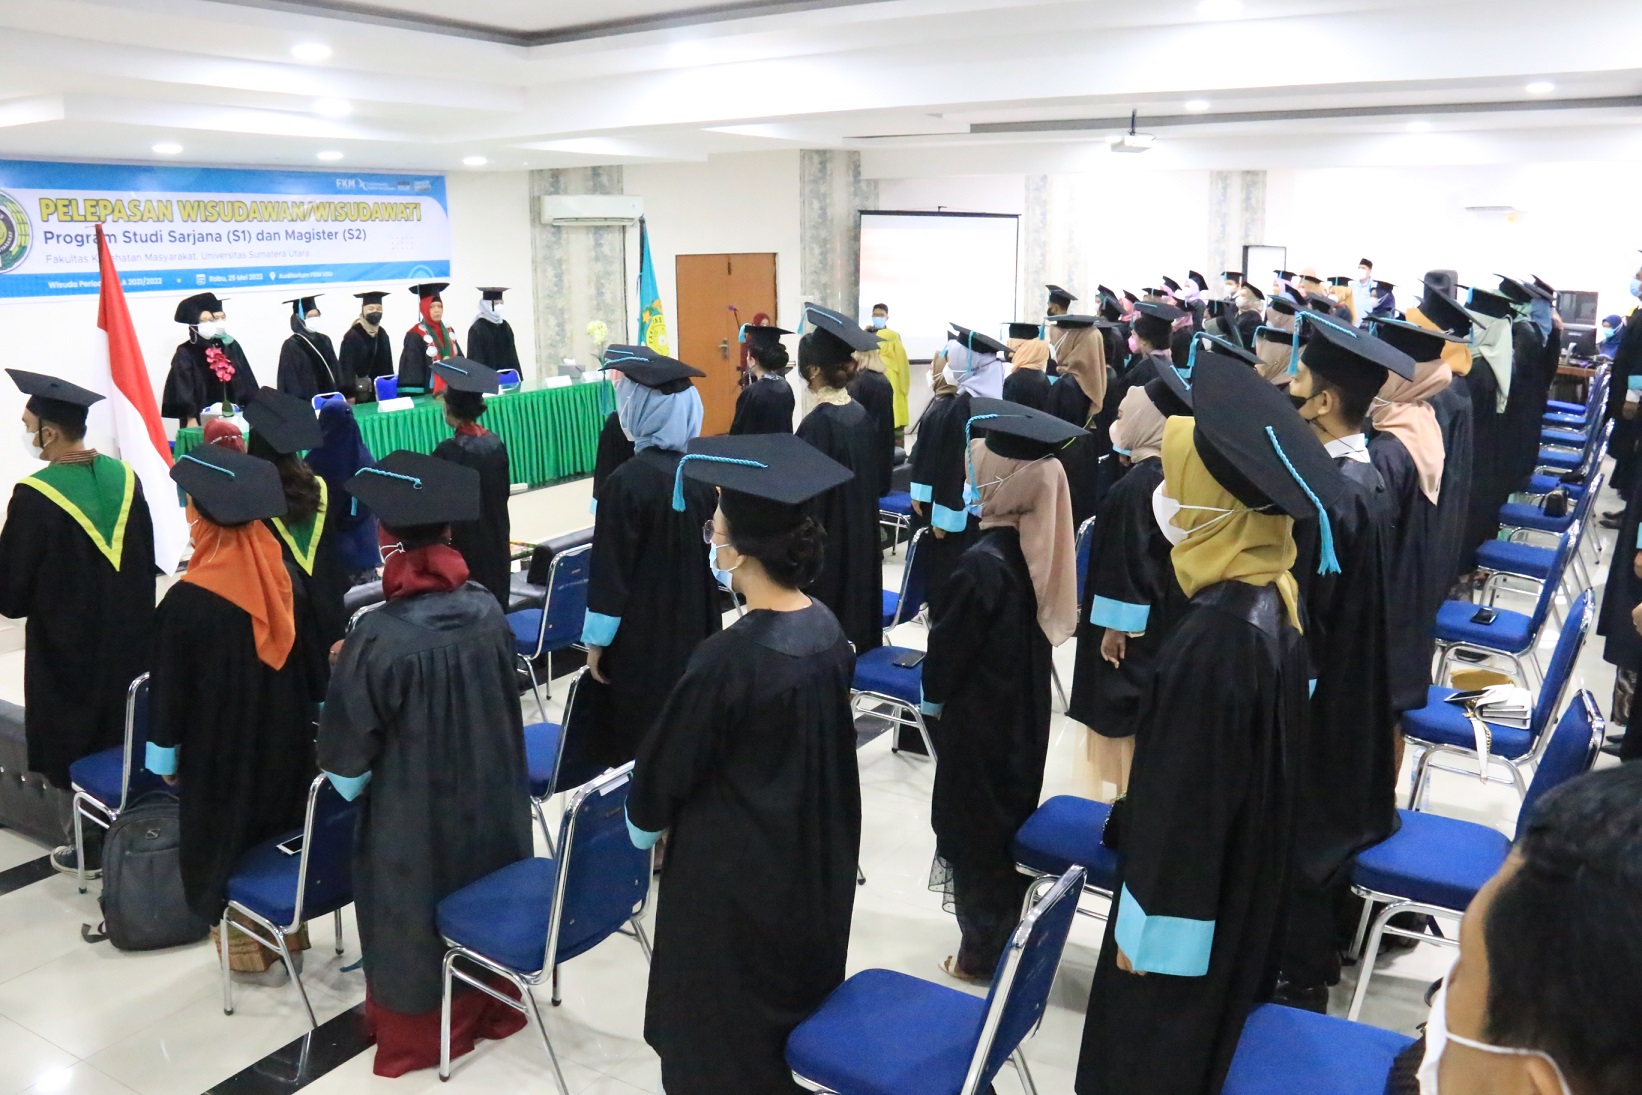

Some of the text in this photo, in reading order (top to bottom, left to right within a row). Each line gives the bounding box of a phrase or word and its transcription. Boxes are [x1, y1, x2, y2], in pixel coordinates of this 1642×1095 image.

[336, 178, 356, 188] FKM
[39, 198, 421, 222] PELEPASAN WISUDAWAN/WISUDAWATI
[44, 228, 367, 247] Program Studi Sarjana (S1) dan Magister (S2)
[46, 254, 89, 264] Fakultas
[201, 250, 246, 261] Universitas
[248, 250, 287, 259] Sumatera
[289, 249, 310, 258] Utara
